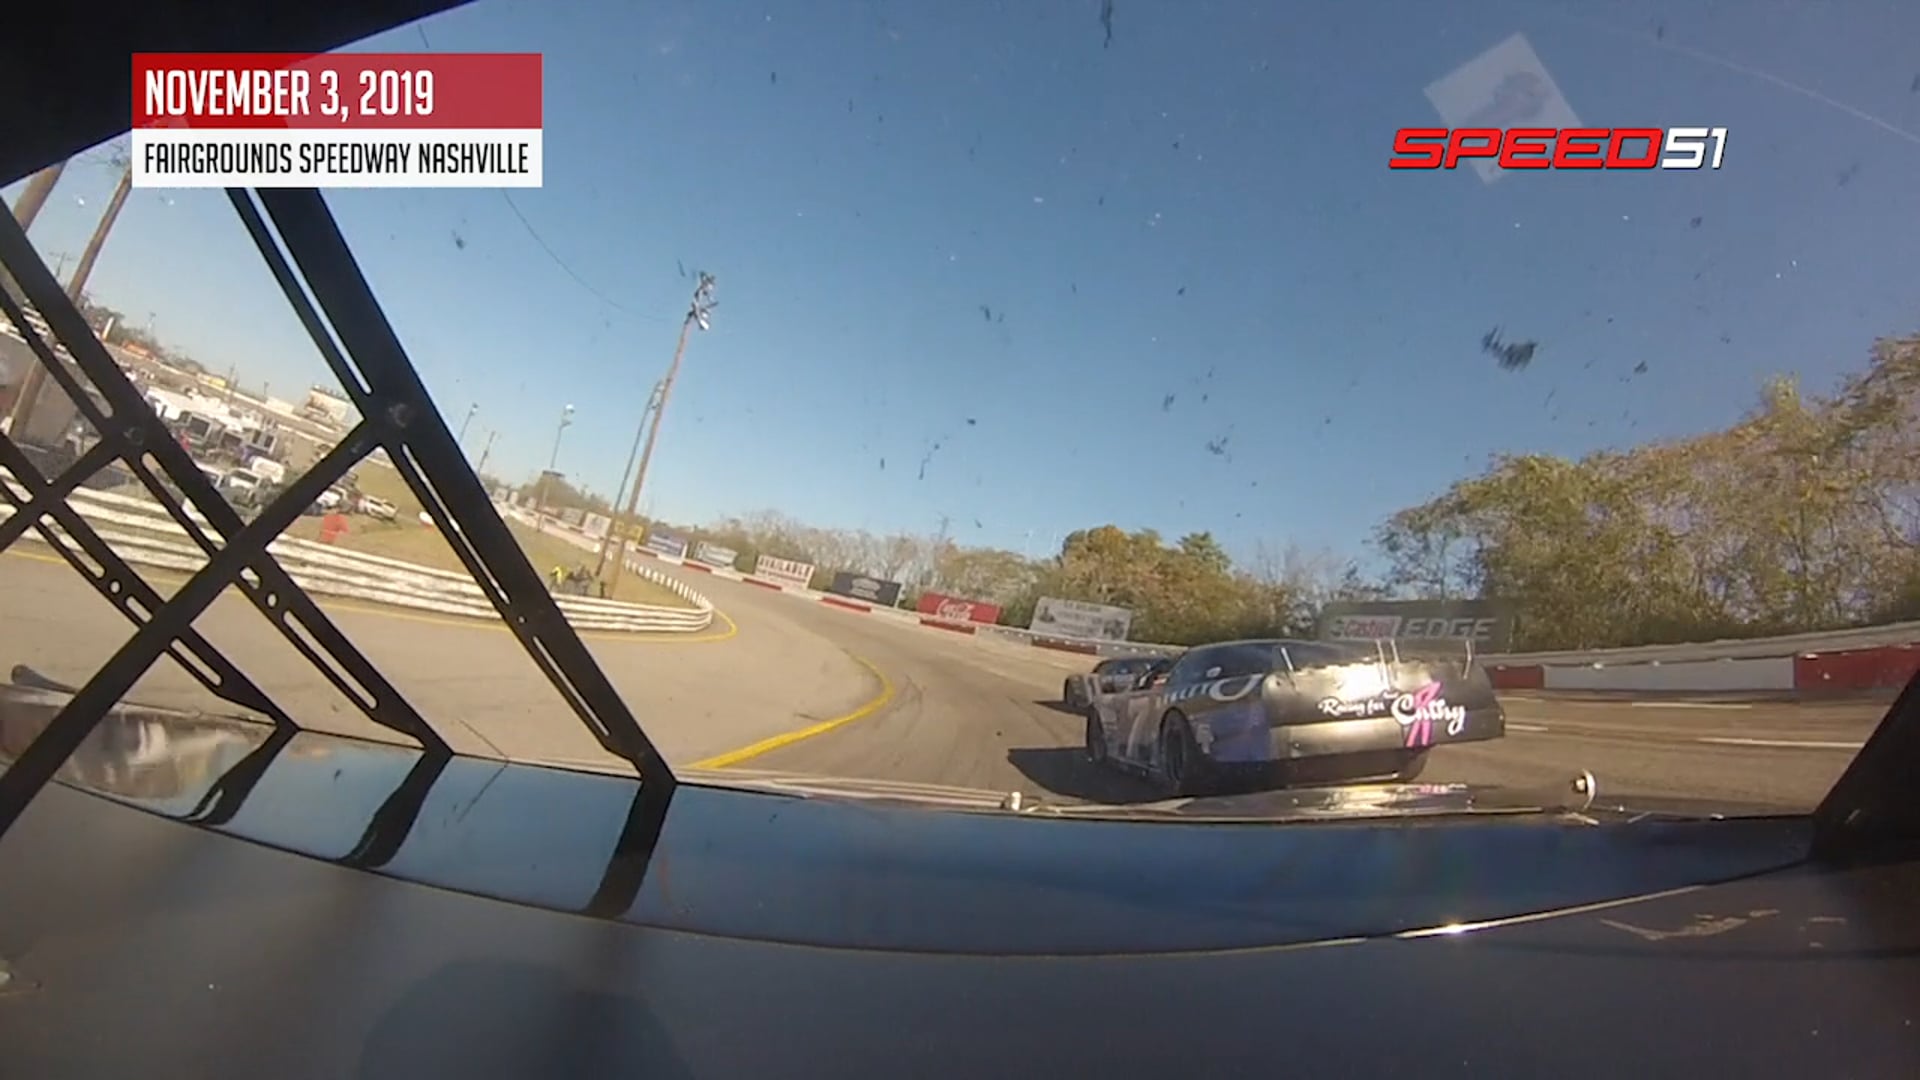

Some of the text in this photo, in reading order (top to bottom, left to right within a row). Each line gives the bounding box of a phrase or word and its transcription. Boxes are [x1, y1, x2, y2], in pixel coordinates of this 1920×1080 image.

[1402, 617, 1497, 641] EDGE
[1318, 698, 1366, 717] Racing
[1390, 693, 1466, 736] Cathy
